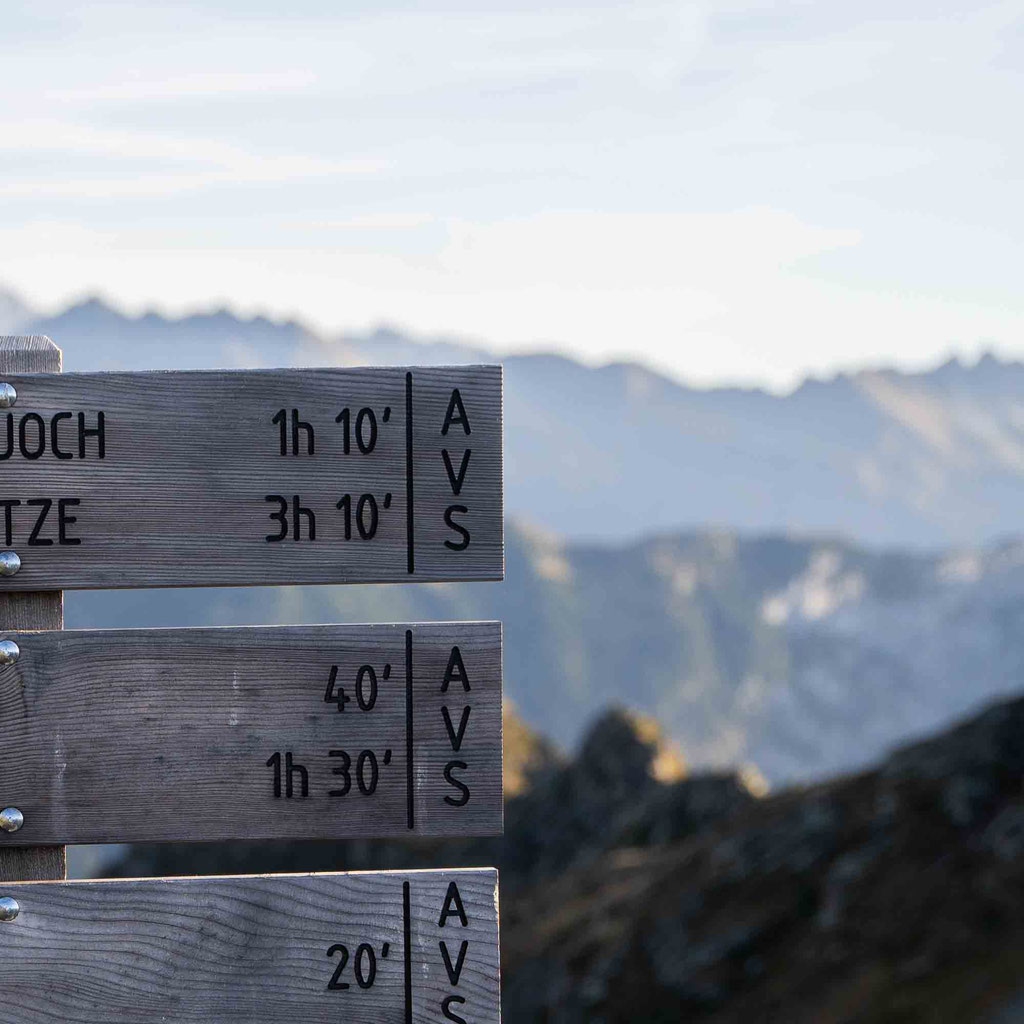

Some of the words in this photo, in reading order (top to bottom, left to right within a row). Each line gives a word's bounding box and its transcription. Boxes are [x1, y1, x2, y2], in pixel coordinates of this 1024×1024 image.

[272, 408, 315, 456] 1h
[265, 495, 316, 543] 3h
[266, 752, 308, 798] 1h
